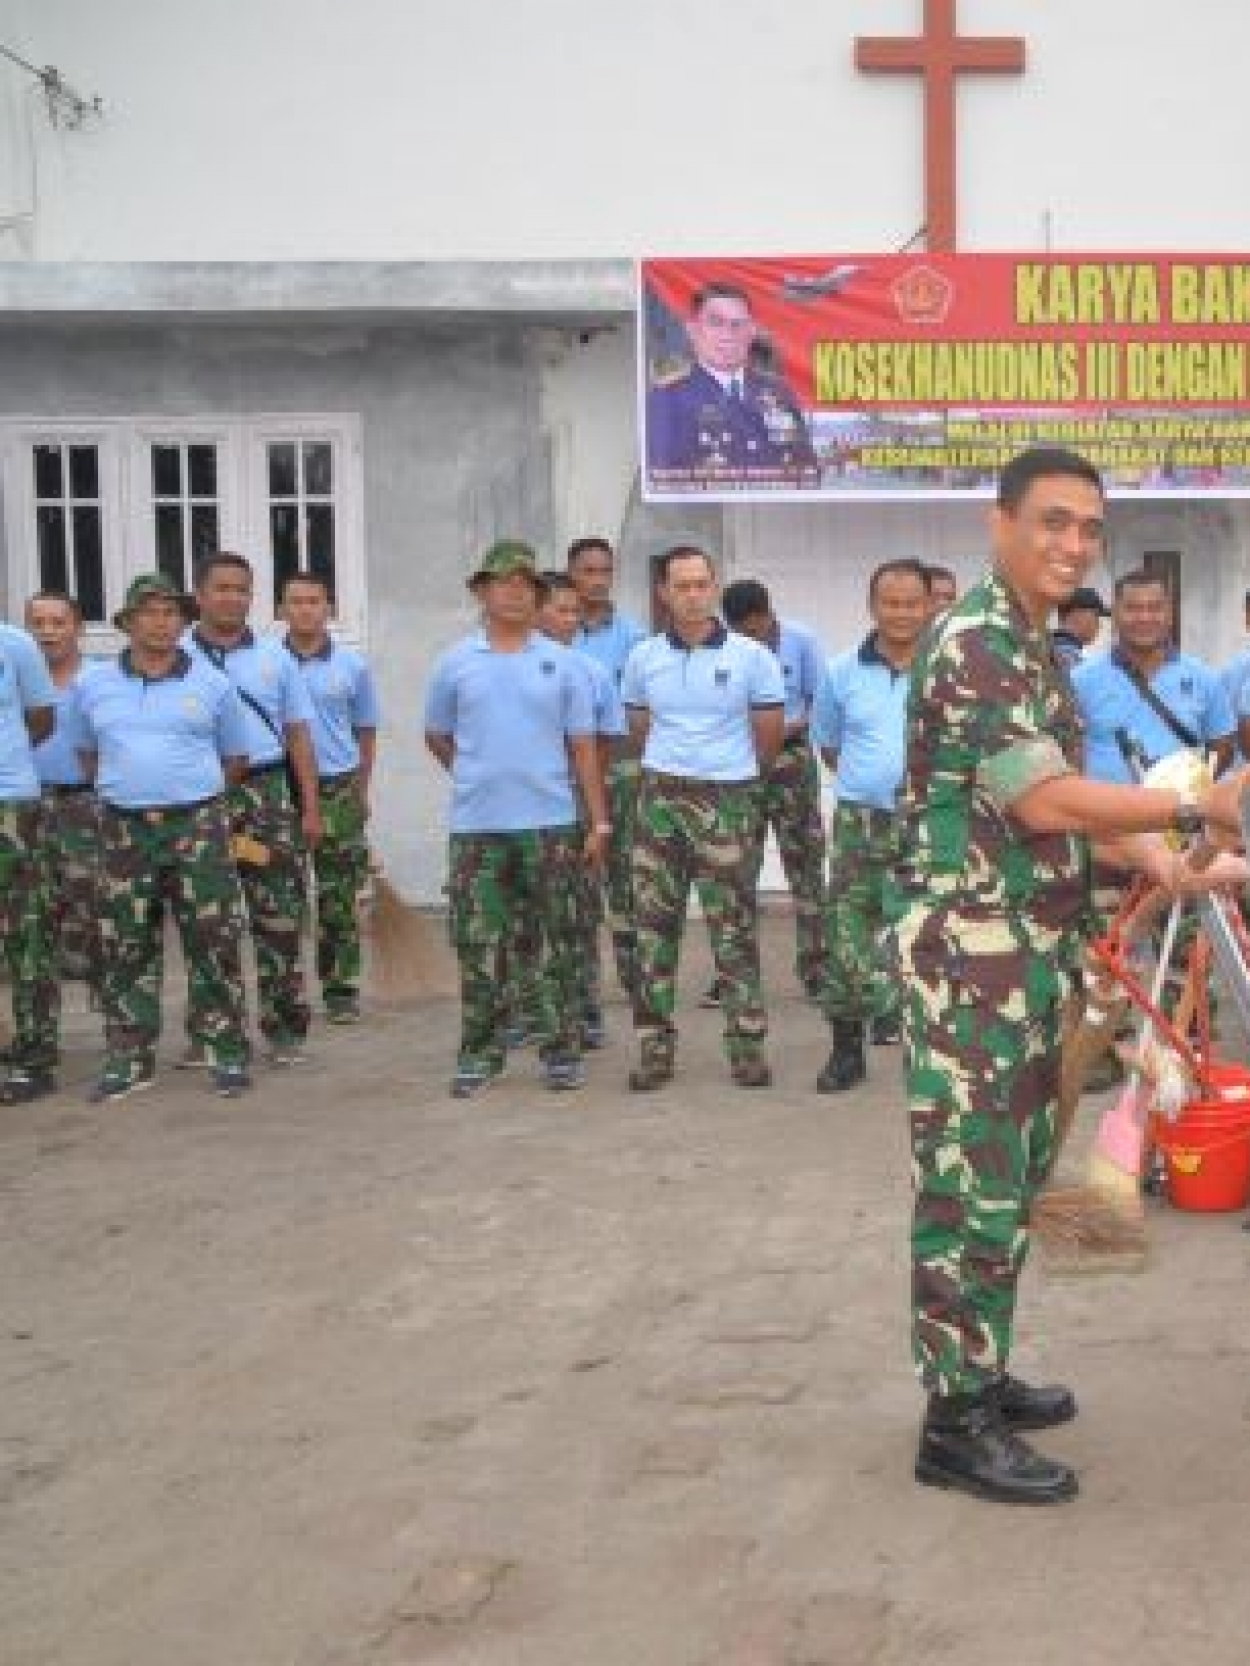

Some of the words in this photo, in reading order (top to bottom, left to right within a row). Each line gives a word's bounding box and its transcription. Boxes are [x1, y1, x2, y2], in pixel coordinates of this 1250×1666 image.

[1015, 263, 1161, 324] KARYA
[815, 341, 1079, 401] KOSEKHANUDNAS
[1086, 341, 1117, 401] III
[1126, 341, 1243, 401] DENGAN
